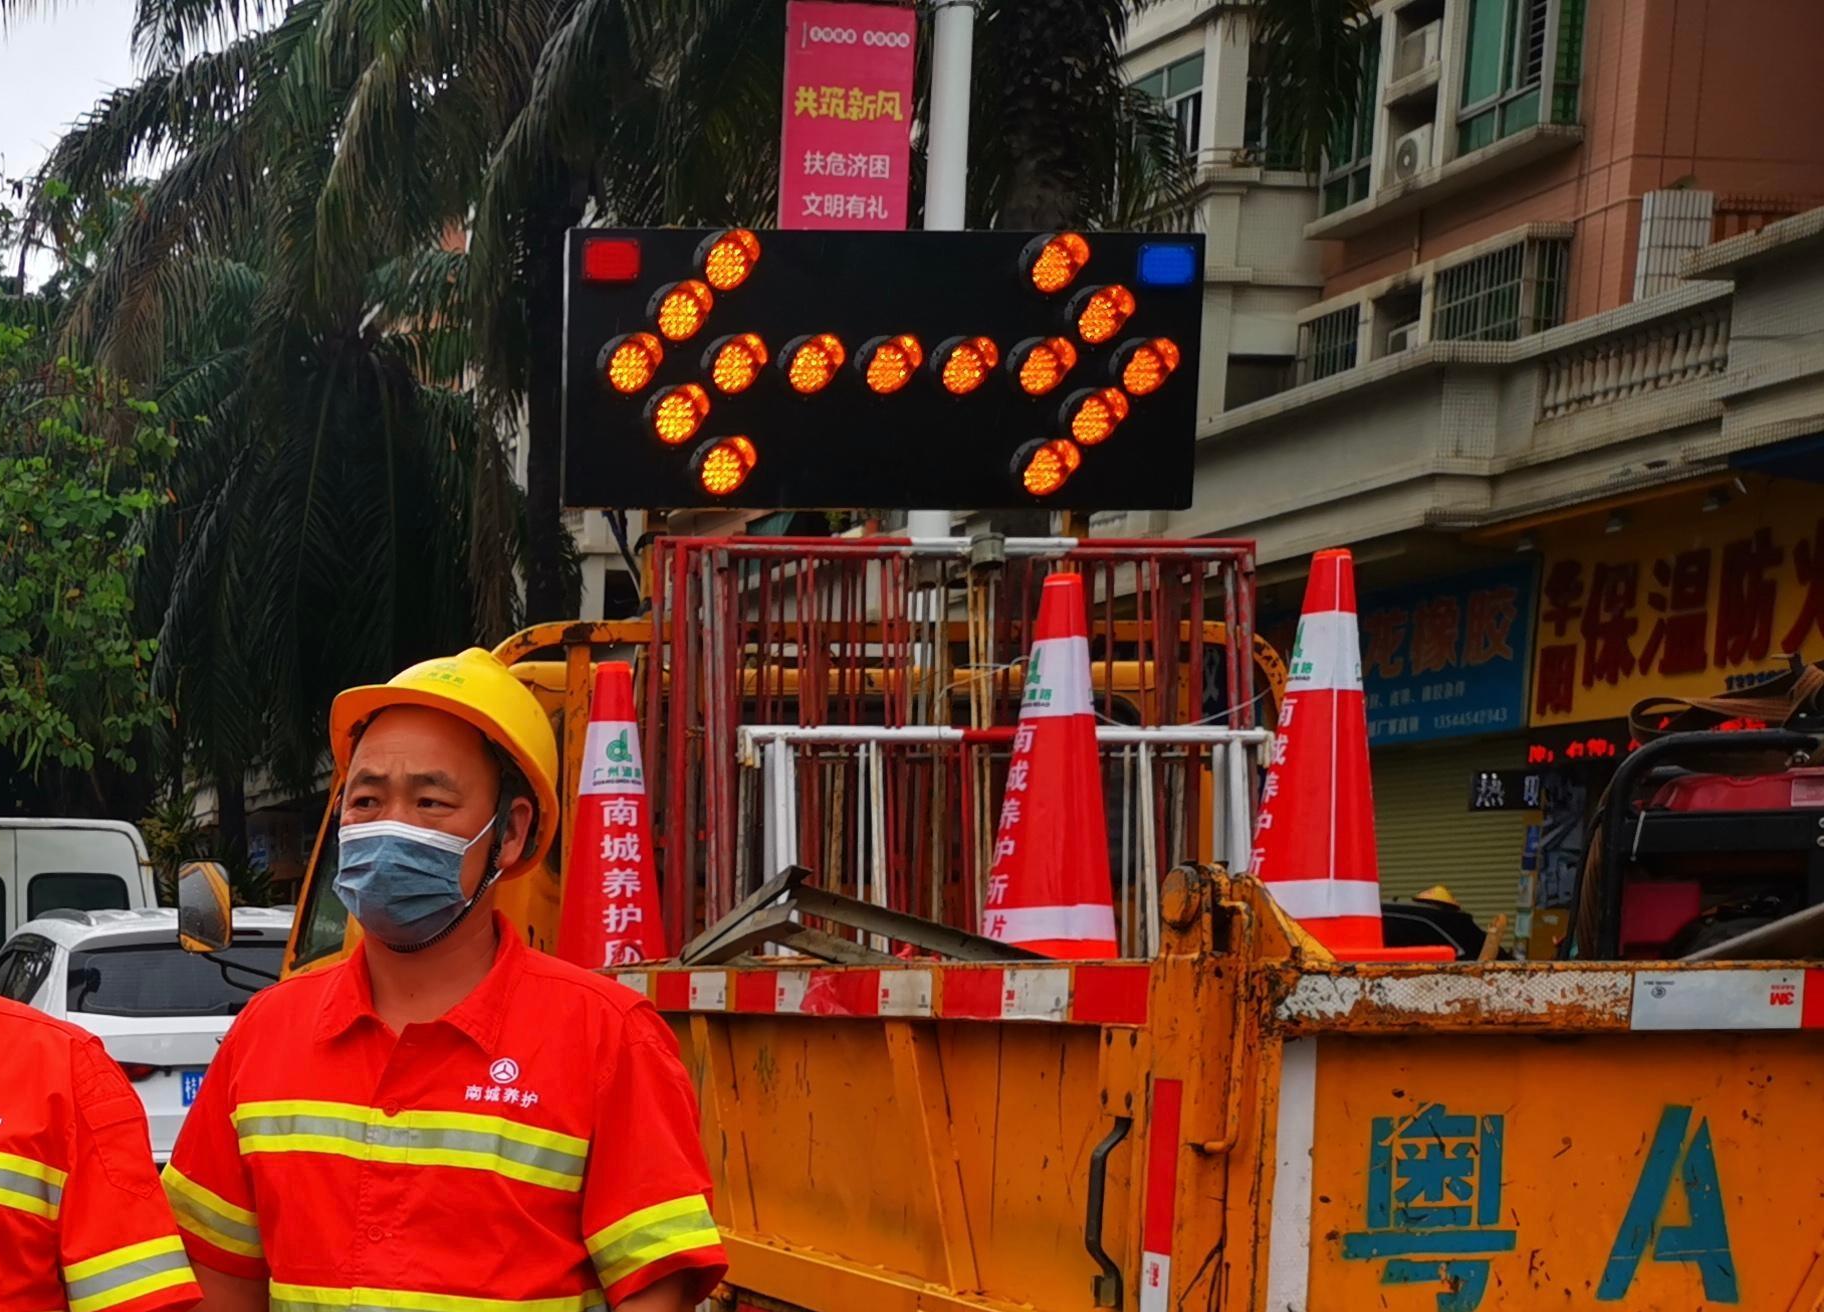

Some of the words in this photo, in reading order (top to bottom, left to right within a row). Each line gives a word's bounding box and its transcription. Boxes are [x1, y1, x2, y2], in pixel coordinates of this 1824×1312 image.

[794, 86, 903, 121] 共筑新风
[803, 150, 890, 179] 扶危济困
[801, 192, 888, 220] 文明有礼
[465, 1084, 539, 1108] 南城养护
[1596, 1104, 1740, 1305] A
